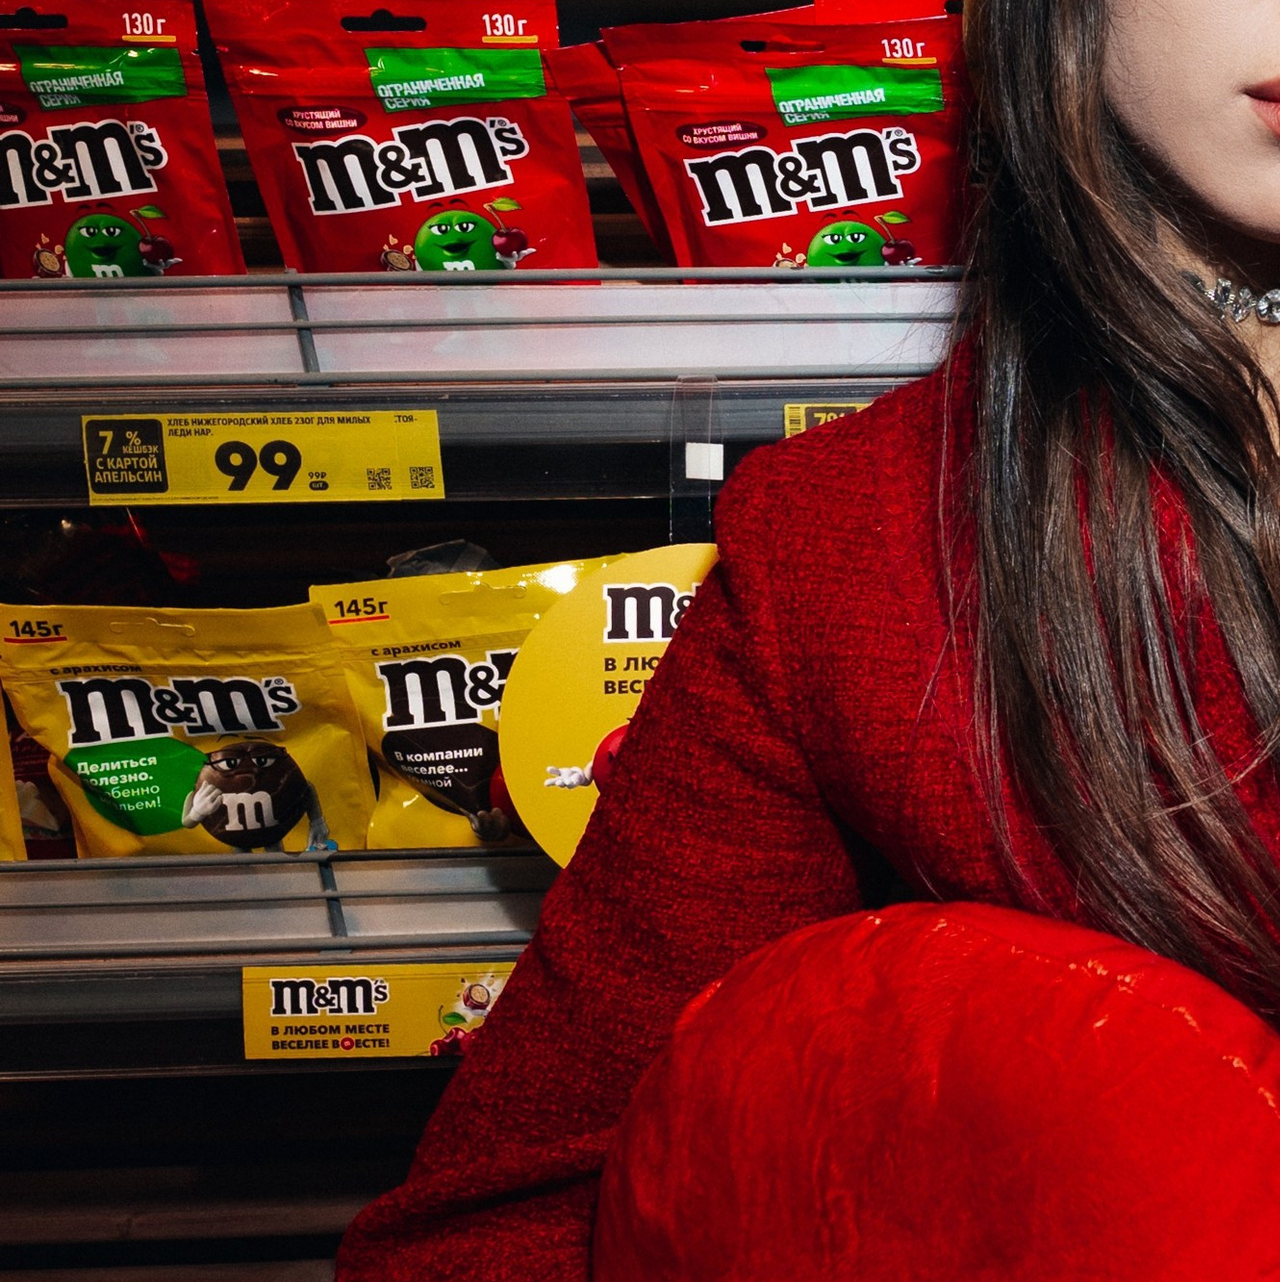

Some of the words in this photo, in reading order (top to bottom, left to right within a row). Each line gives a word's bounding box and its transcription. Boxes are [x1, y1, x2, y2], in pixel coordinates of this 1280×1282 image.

[29, 71, 125, 93] ОГРАНИЧЕННАЯ
[377, 73, 485, 98] ОГРАНИЧЕННАЯ
[384, 96, 431, 110] СЕРИЯ
[779, 88, 886, 114] ОГРАНИЧЕННАЯ
[292, 108, 341, 121] ХРУСТЯЩИЙ
[326, 119, 358, 129] ВИШНИ
[693, 123, 743, 136] ХРУСТЯЩИЙ
[693, 133, 727, 145] ВКУСОМ
[728, 131, 758, 143] ВИШНИ
[167, 417, 190, 427] ХЛЕБ
[192, 415, 268, 427] НИЖЕГОРОДСКИЙ
[270, 416, 293, 426] ХЛЕБ
[317, 416, 336, 426] ДЛЯ
[339, 416, 371, 425] МИЛЫХ
[168, 428, 192, 438] ЛЕДИ
[98, 430, 114, 455] 7
[122, 444, 159, 455] КЕШБЭК
[107, 455, 158, 470] КАРТОЙ
[214, 439, 302, 492] 99
[94, 470, 163, 484] АПЕЛЬСИН
[334, 597, 388, 618] 145г
[10, 619, 65, 638] 145г
[381, 640, 462, 658] арахисом
[58, 663, 143, 675] арахисом
[406, 747, 484, 763] компании
[76, 756, 158, 775] Делиться
[222, 793, 278, 831] m
[271, 1025, 280, 1036] В
[283, 1025, 341, 1036] ЛЮБОМ
[344, 1024, 390, 1035] МЕСТЕ
[272, 1039, 329, 1050] ВЕСЕЛЕЕ
